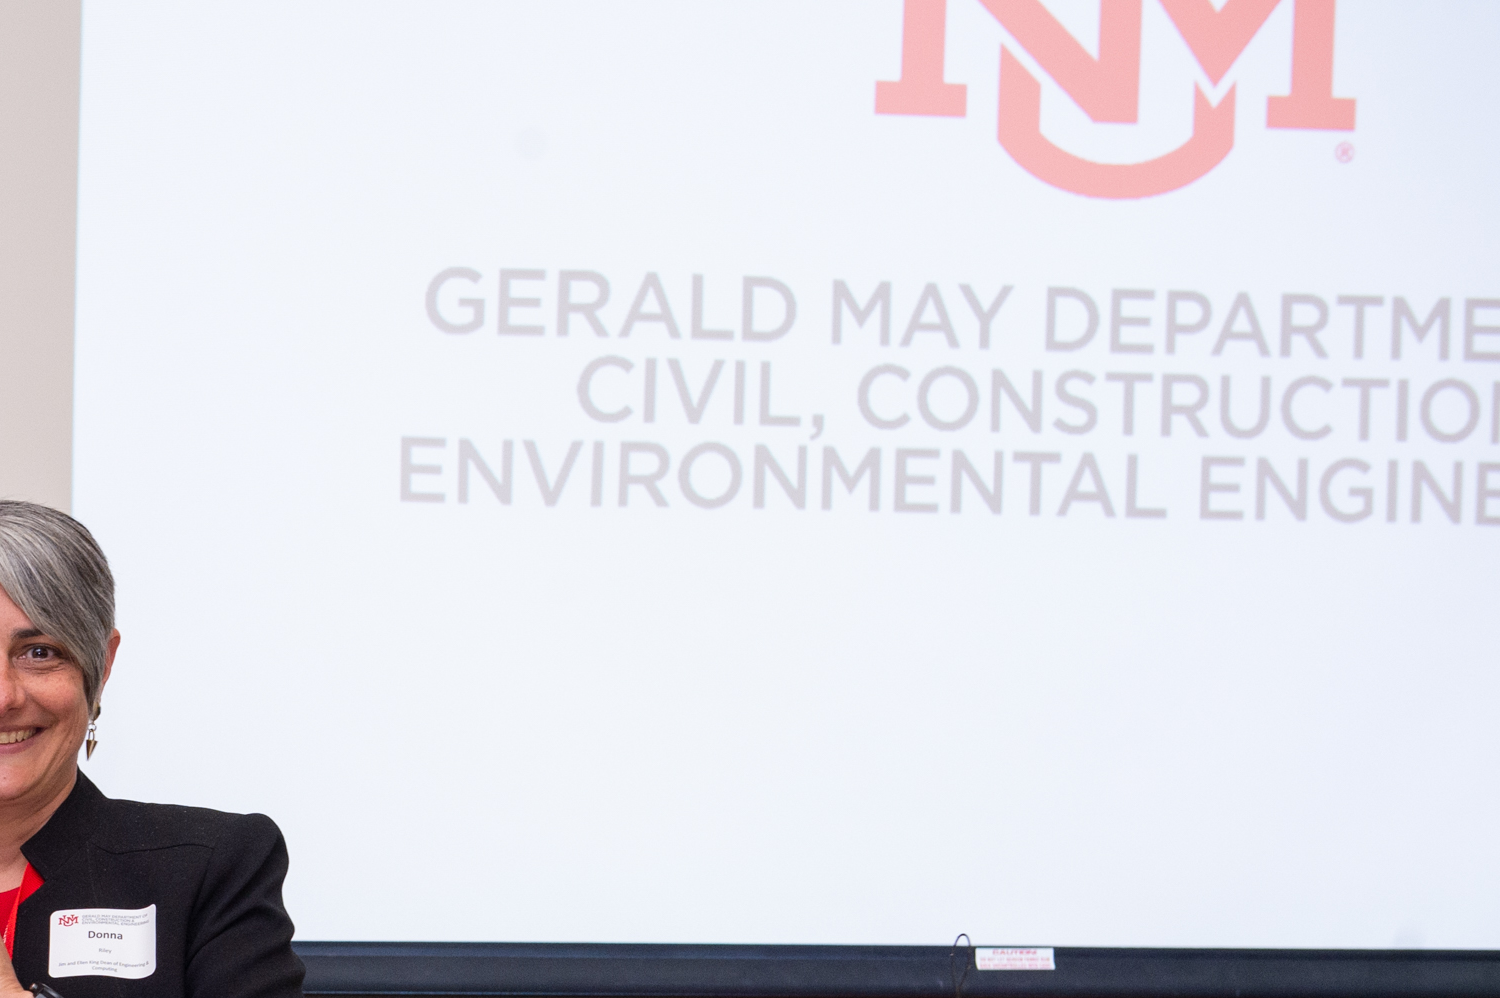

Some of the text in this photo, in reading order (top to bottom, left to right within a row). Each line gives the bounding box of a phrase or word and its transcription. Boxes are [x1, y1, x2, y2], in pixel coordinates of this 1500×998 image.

[424, 266, 1500, 362] GERALD MAY DEPARTME
[576, 355, 1500, 445] CIVIL, CONSTRUCTIO
[399, 436, 1167, 519] ENVIRONMENTAL
[88, 931, 123, 940] Donna
